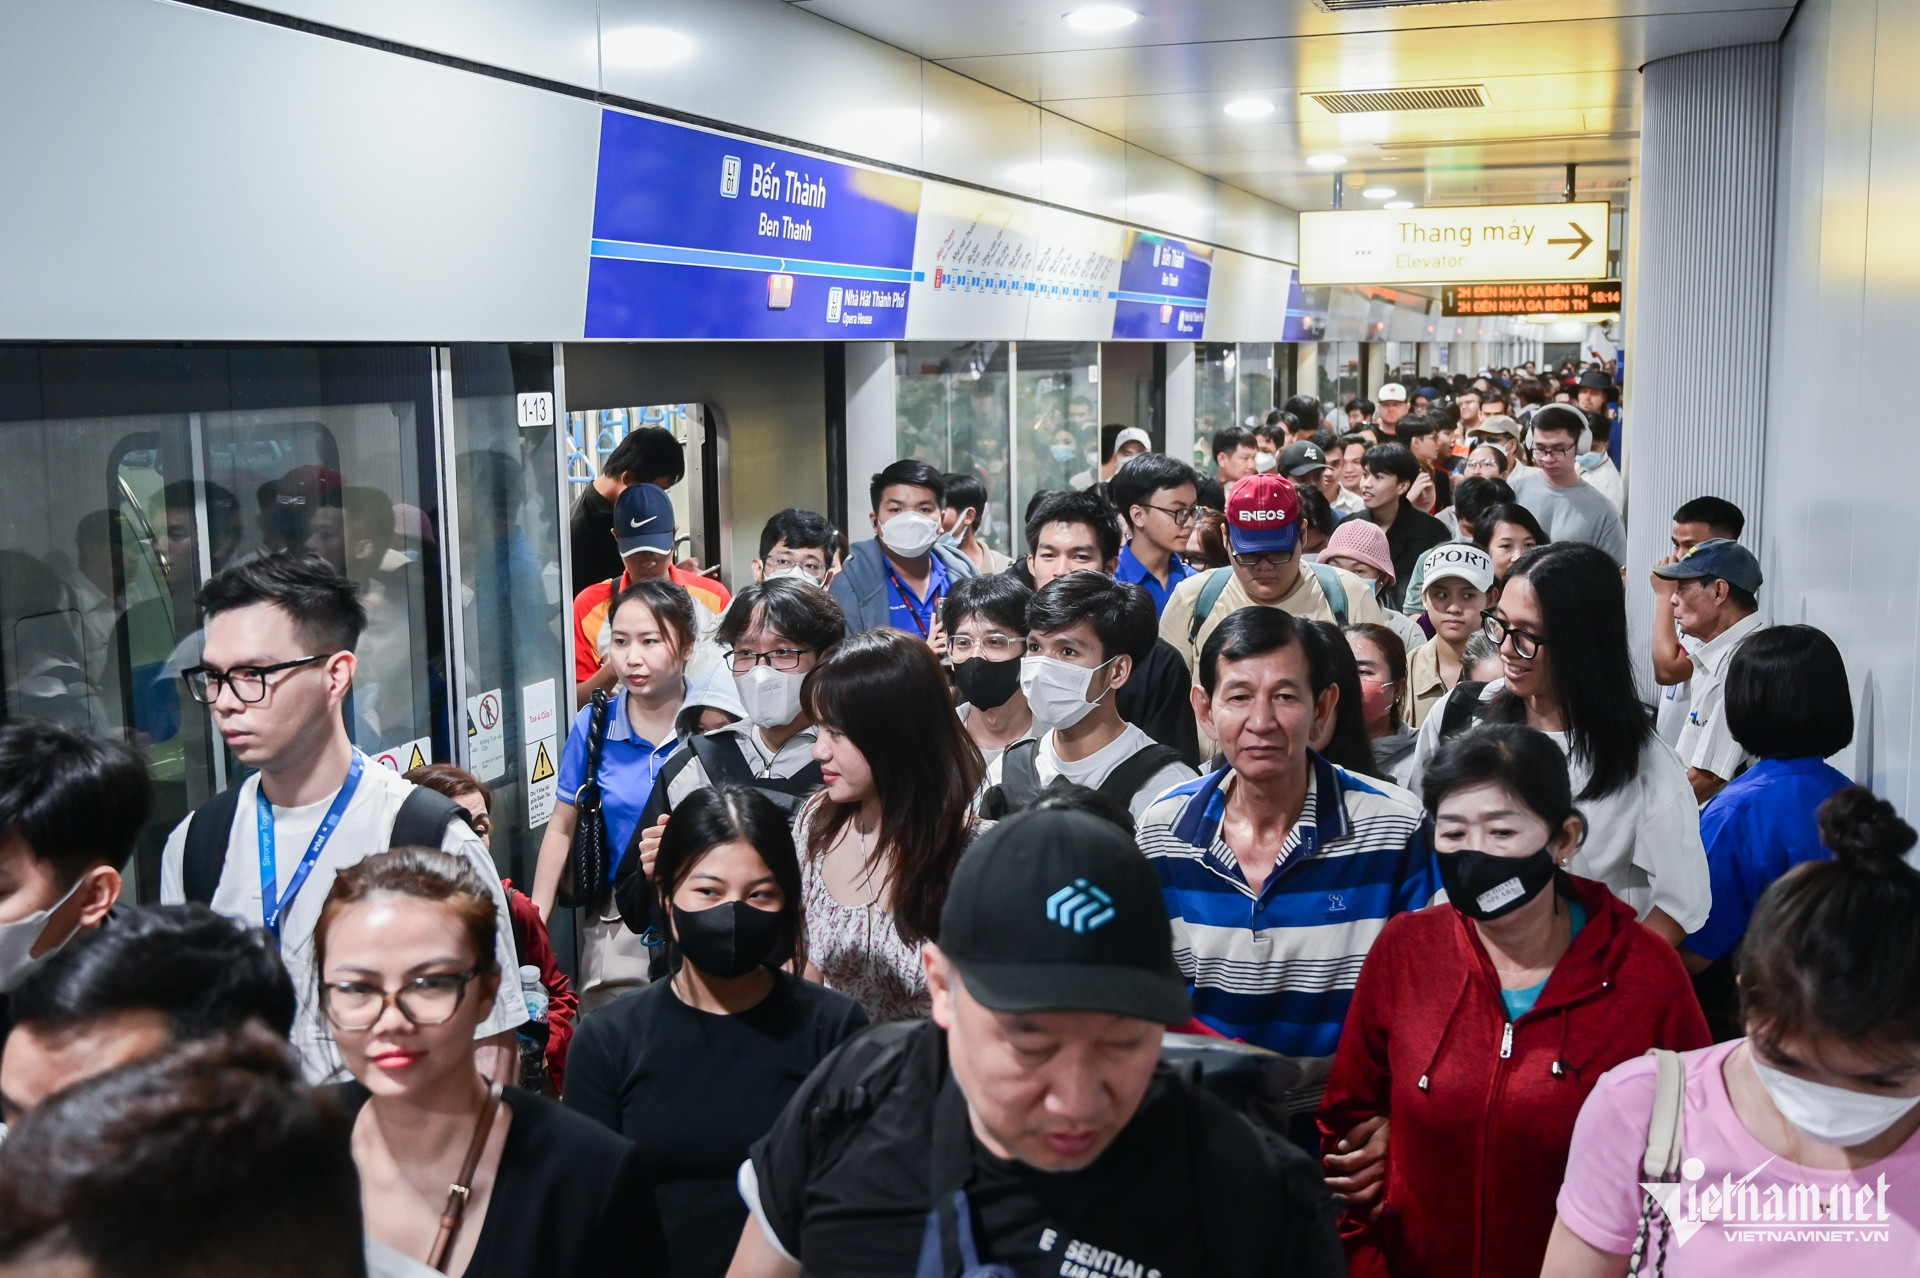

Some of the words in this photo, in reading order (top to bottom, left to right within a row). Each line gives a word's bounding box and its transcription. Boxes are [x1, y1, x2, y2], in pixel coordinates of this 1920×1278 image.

[728, 162, 735, 176] L1
[727, 178, 734, 191] 01
[751, 162, 780, 200] Bến
[785, 170, 826, 208] Thành
[758, 212, 779, 237] Ben
[782, 215, 812, 242] Thanh
[1398, 222, 1472, 247] Thang
[1483, 219, 1535, 245] máy
[1396, 253, 1465, 269] Elevator
[844, 289, 858, 306] Nhà
[859, 290, 871, 307] Hát
[872, 290, 891, 308] Thành
[892, 290, 906, 308] Phố
[1447, 291, 1453, 307] 1
[1526, 285, 1543, 297] GA
[1572, 285, 1588, 296] TH
[1526, 300, 1543, 312] GA
[1572, 299, 1588, 311] TH
[842, 312, 857, 327] Opera
[857, 313, 873, 325] House
[523, 397, 547, 422] 1-13
[1239, 510, 1285, 521] ENEOS
[1425, 550, 1489, 573] SPORT
[262, 832, 271, 867] Stronger
[1038, 1228, 1162, 1278] ESENTIALS
